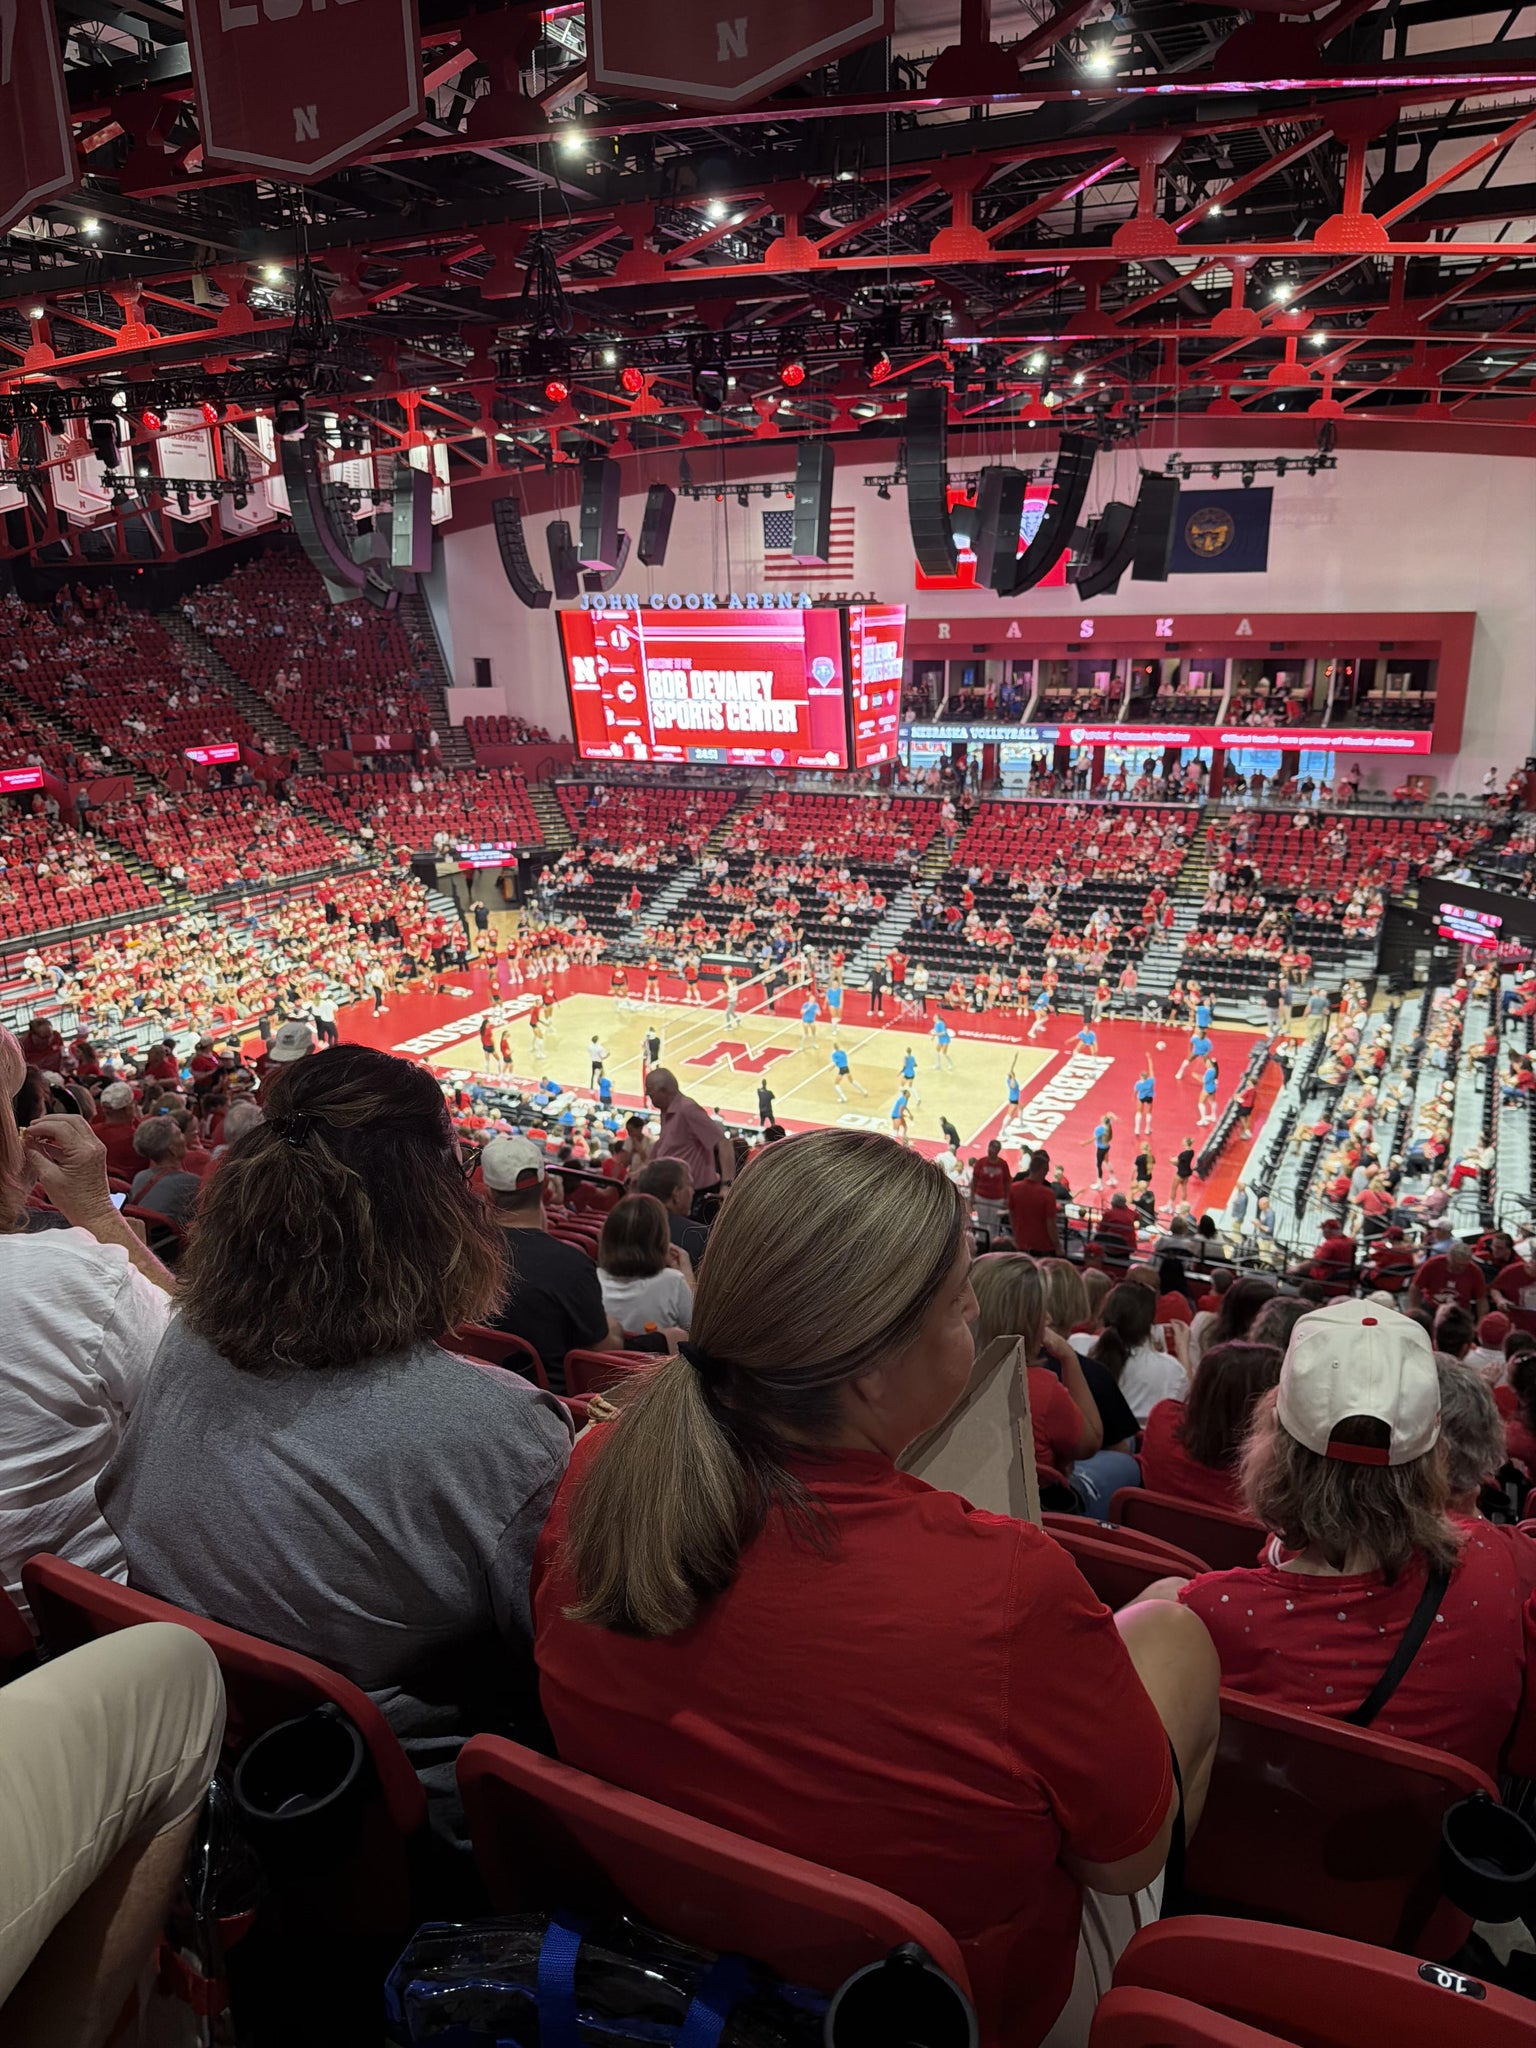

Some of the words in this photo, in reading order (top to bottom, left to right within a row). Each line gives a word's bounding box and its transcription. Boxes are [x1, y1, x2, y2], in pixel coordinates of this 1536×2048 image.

[715, 16, 748, 62] N
[292, 104, 320, 143] N
[580, 593, 640, 611] JOHN
[650, 592, 718, 610] COOK
[728, 591, 813, 610] ARENA
[572, 656, 598, 683] N
[648, 669, 689, 700] BOB
[690, 670, 774, 701] DEVANEY
[652, 700, 725, 731] SPORTS
[726, 702, 798, 732] CENTER
[374, 735, 392, 750] N
[970, 727, 1039, 740] VOLLEYBALL
[680, 1040, 800, 1075] N
[996, 1052, 1116, 1151] NEBRASKA
